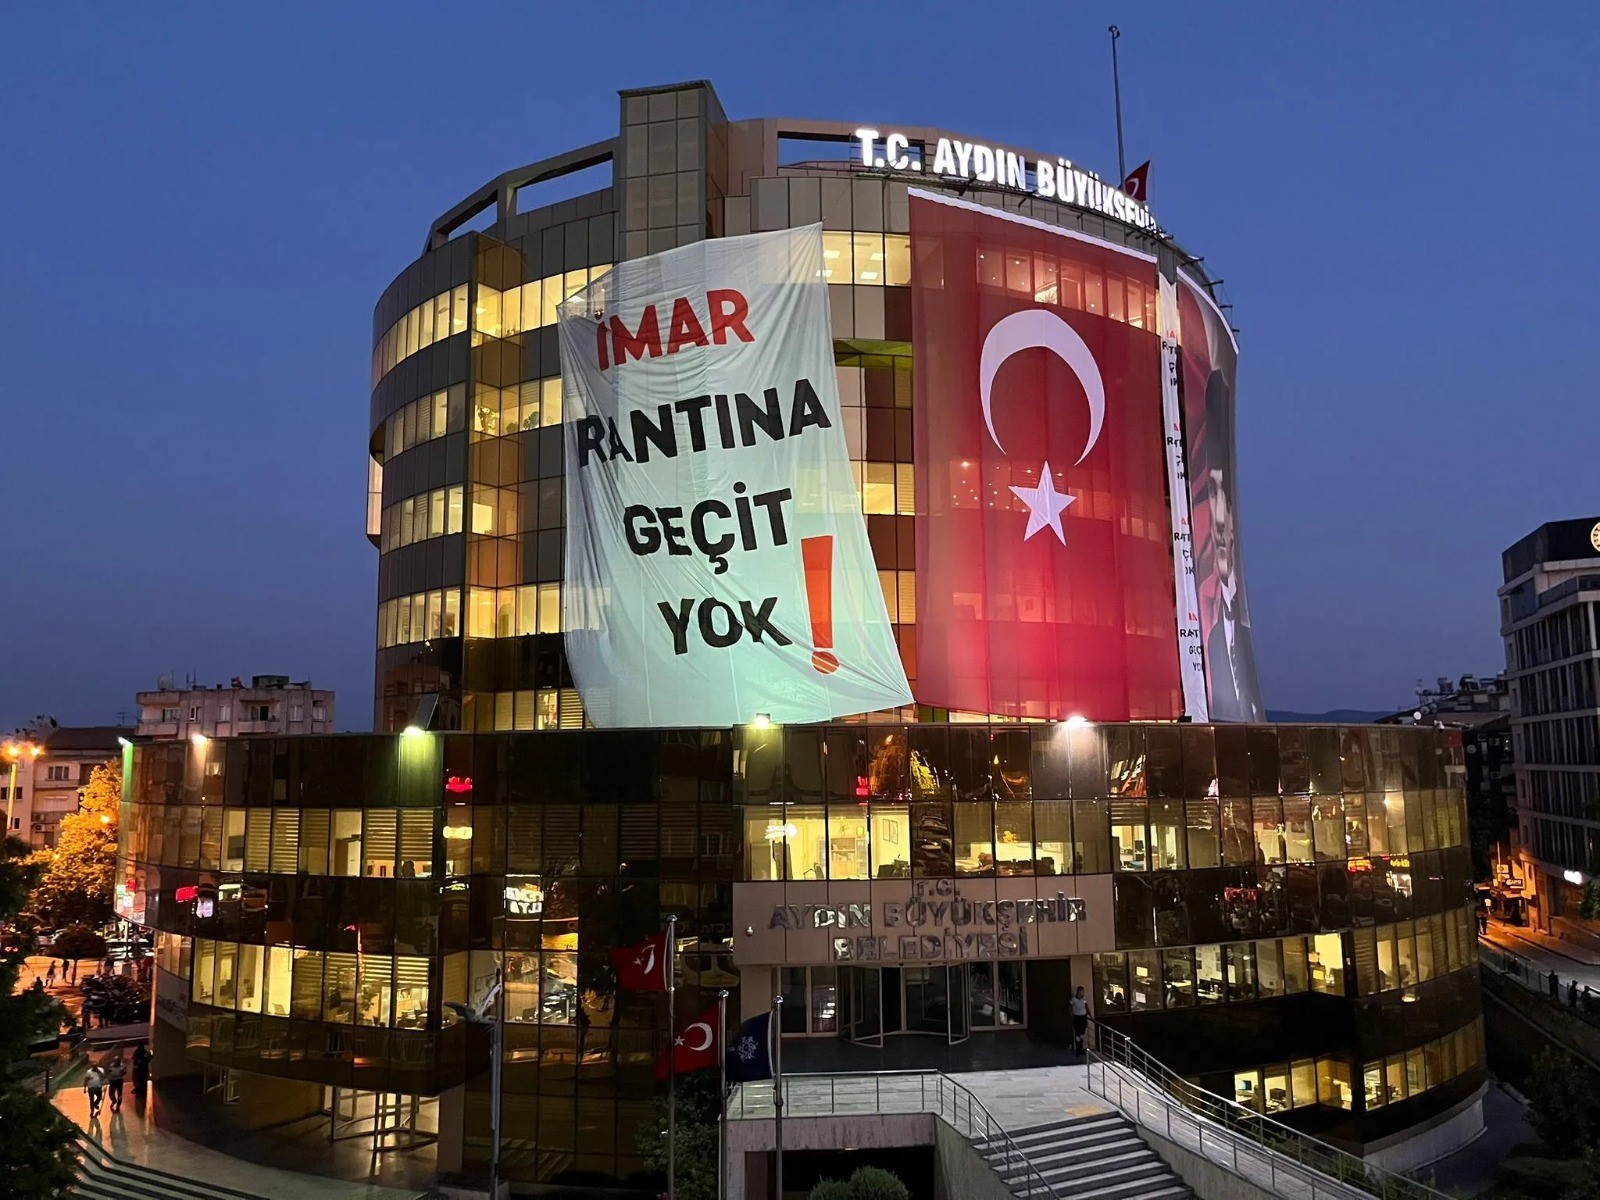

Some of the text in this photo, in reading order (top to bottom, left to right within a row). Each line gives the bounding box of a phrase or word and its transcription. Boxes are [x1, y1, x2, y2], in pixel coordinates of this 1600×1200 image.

[856, 128, 922, 171] T.C.
[932, 137, 1026, 191] AYDIN
[595, 288, 755, 372] İMAR
[576, 378, 832, 467] RANTINA
[623, 480, 793, 575] GEÇİT
[768, 891, 1087, 931] AYDIN BÜYÜKŞEHİR
[913, 877, 960, 897] T.C.
[833, 926, 1028, 960] BELEDİYESİ
